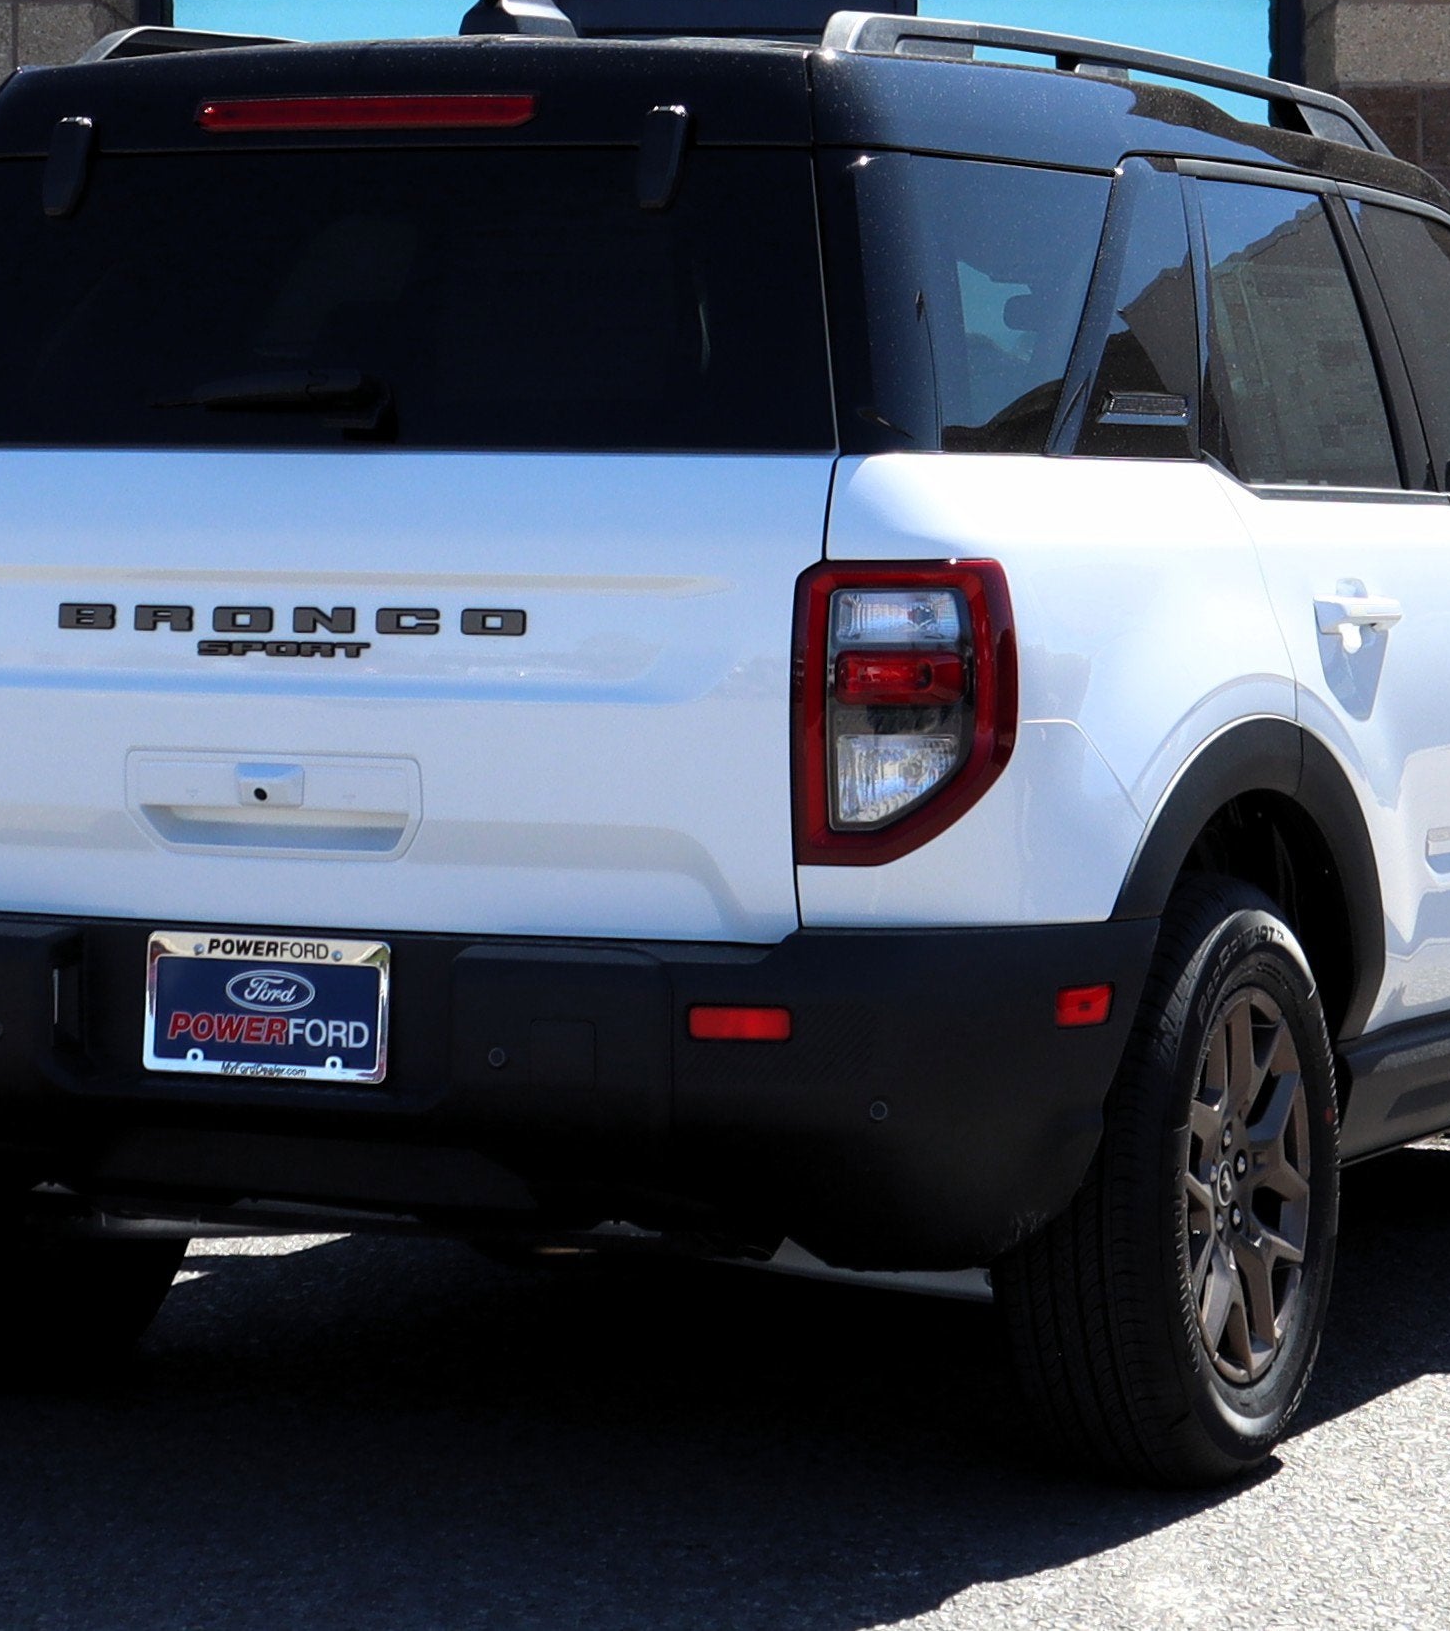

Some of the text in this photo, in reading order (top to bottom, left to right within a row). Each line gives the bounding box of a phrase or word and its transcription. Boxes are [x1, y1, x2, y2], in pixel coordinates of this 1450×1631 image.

[57, 602, 528, 636] BRONCO
[196, 639, 371, 659] SPORT
[207, 938, 330, 960] POWERFORD
[243, 976, 297, 1004] Ford
[166, 1010, 370, 1049] POWERFORD
